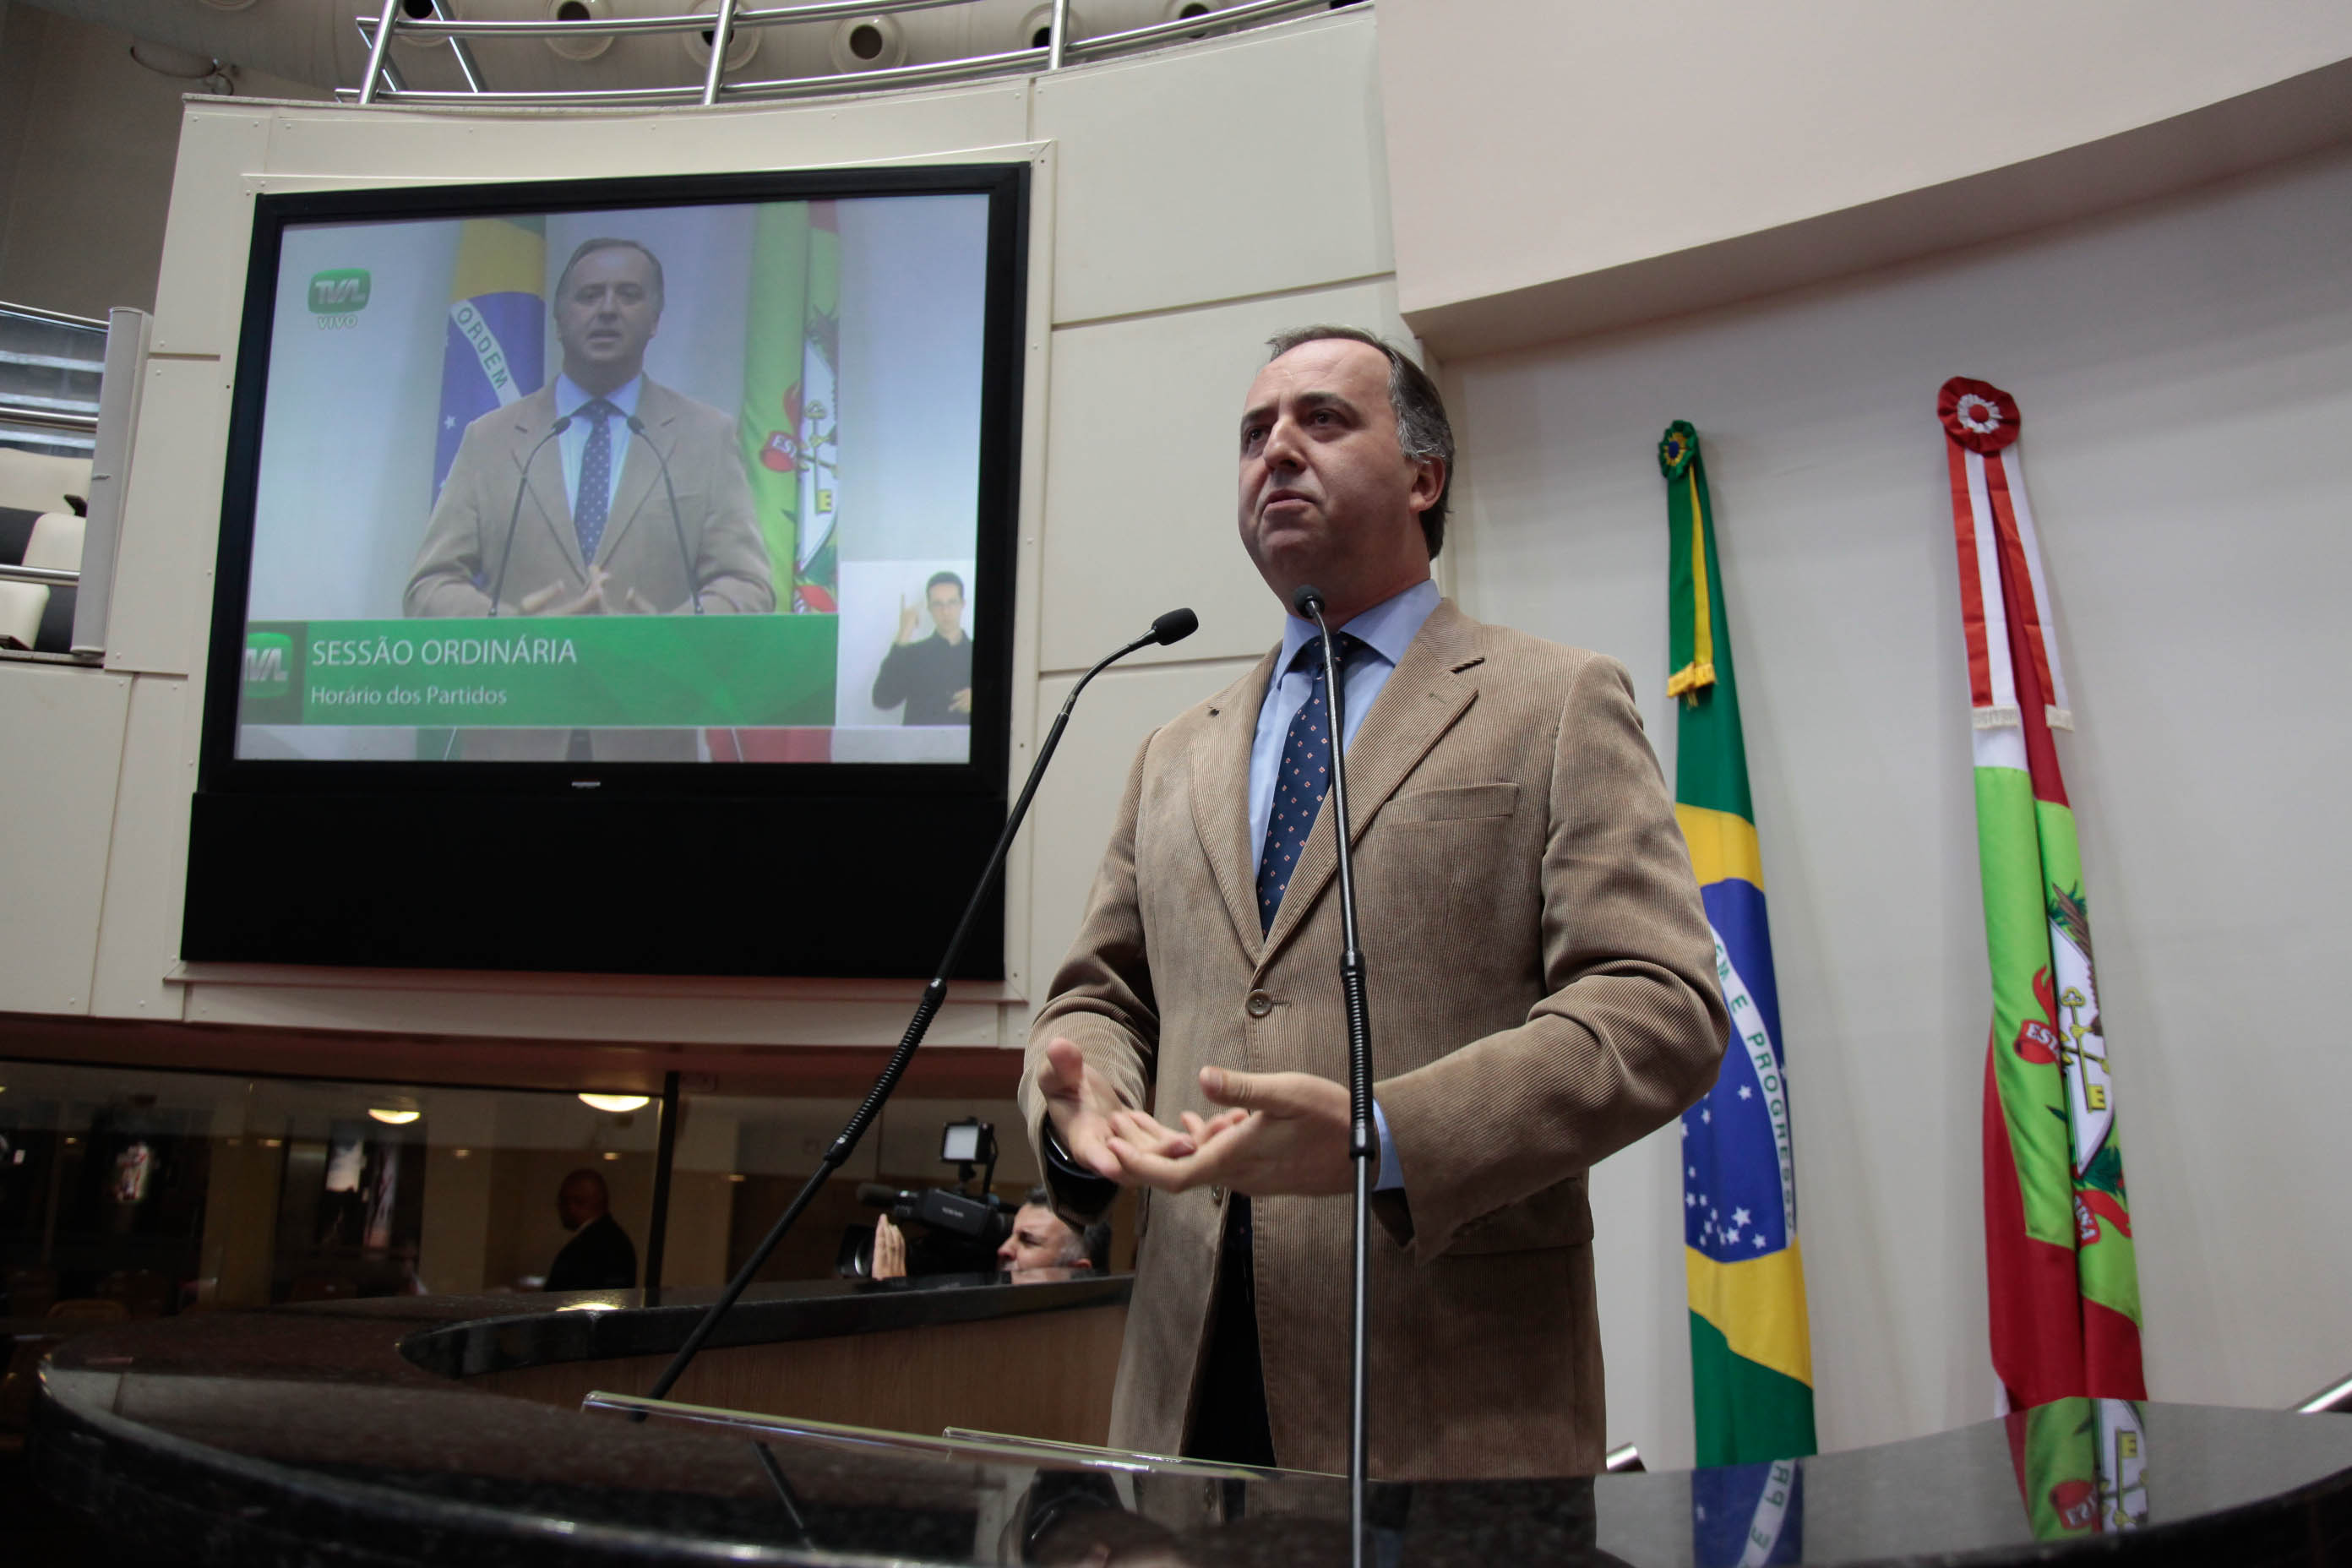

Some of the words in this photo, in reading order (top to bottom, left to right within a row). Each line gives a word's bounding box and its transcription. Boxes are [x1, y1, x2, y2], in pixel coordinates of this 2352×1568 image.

[318, 315, 357, 329] VIVO
[457, 307, 509, 389] ORDEM
[312, 635, 414, 666] SESSÃO
[422, 635, 578, 665] ORDINÁRIA
[311, 686, 382, 705] Horário
[386, 686, 422, 705] dos
[426, 685, 507, 705] Partidos
